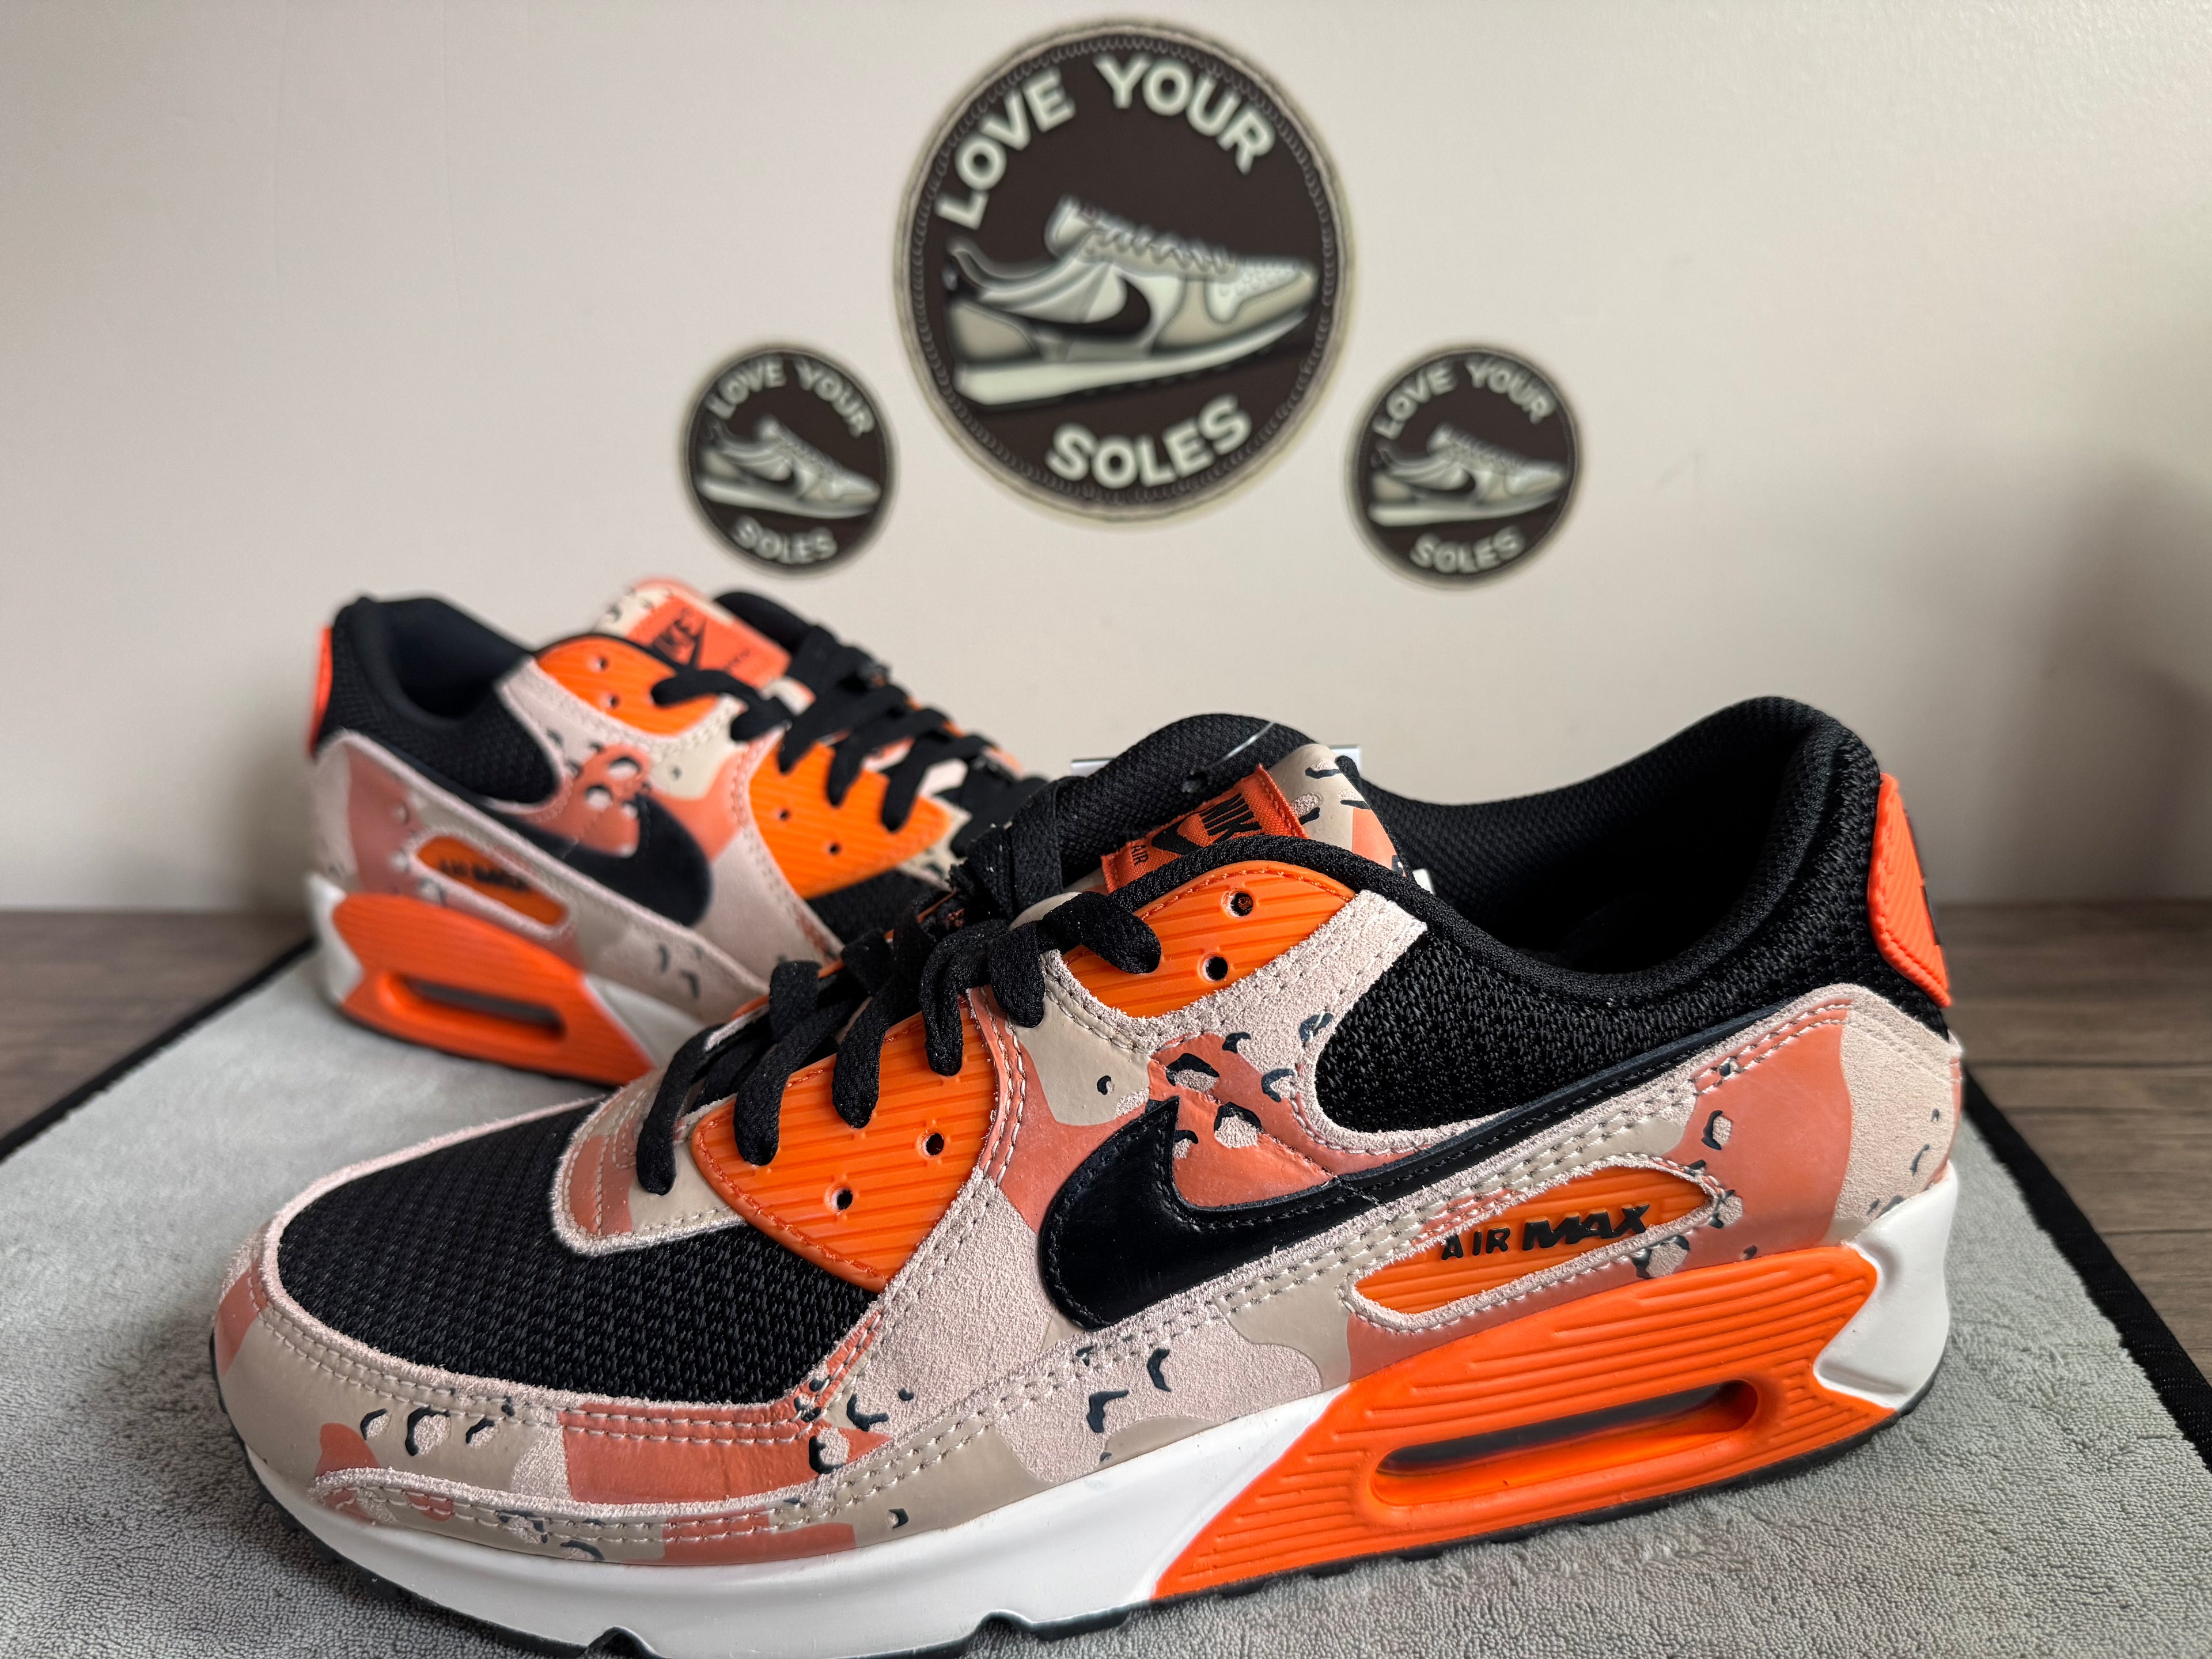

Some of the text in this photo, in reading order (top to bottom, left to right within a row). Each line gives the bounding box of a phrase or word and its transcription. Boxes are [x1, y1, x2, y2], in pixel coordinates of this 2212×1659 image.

[935, 53, 1276, 229] LOVE YOUR
[705, 355, 875, 438] LOVE YOUR
[1373, 355, 1555, 440] LOVE YOUR
[1046, 393, 1252, 489] SOLES
[731, 516, 838, 565] SOLES
[1409, 525, 1526, 574] SOLES
[1199, 793, 1264, 844] NIK
[1131, 844, 1149, 866] AIR
[1441, 1203, 1650, 1260] AIR MAX
